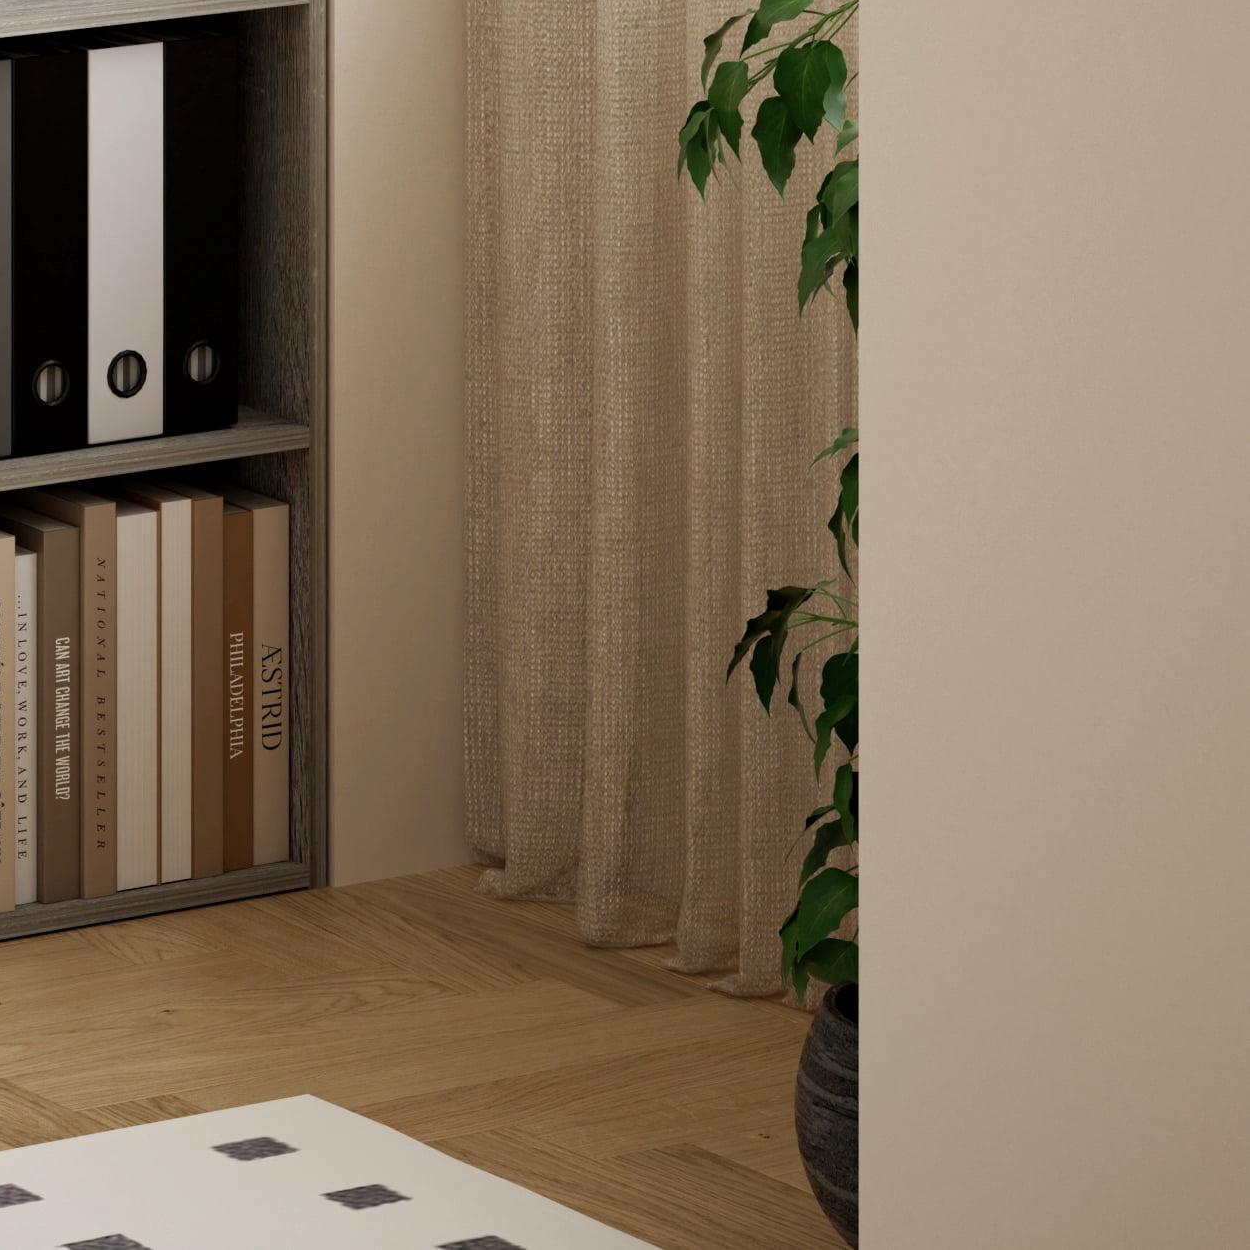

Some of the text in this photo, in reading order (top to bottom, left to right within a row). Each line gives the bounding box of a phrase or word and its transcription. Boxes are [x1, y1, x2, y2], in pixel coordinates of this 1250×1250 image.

[16, 639, 28, 695] LOVE,
[96, 557, 106, 849] NATIONAL BESTSELLER
[230, 631, 244, 760] PHILADELPHIA
[261, 644, 282, 751] ÆSTRID
[16, 699, 28, 760] WORK,
[55, 636, 70, 800] CAN ART CHANGE THE WORLD?
[17, 766, 28, 804] AND
[17, 816, 28, 859] LIFE
